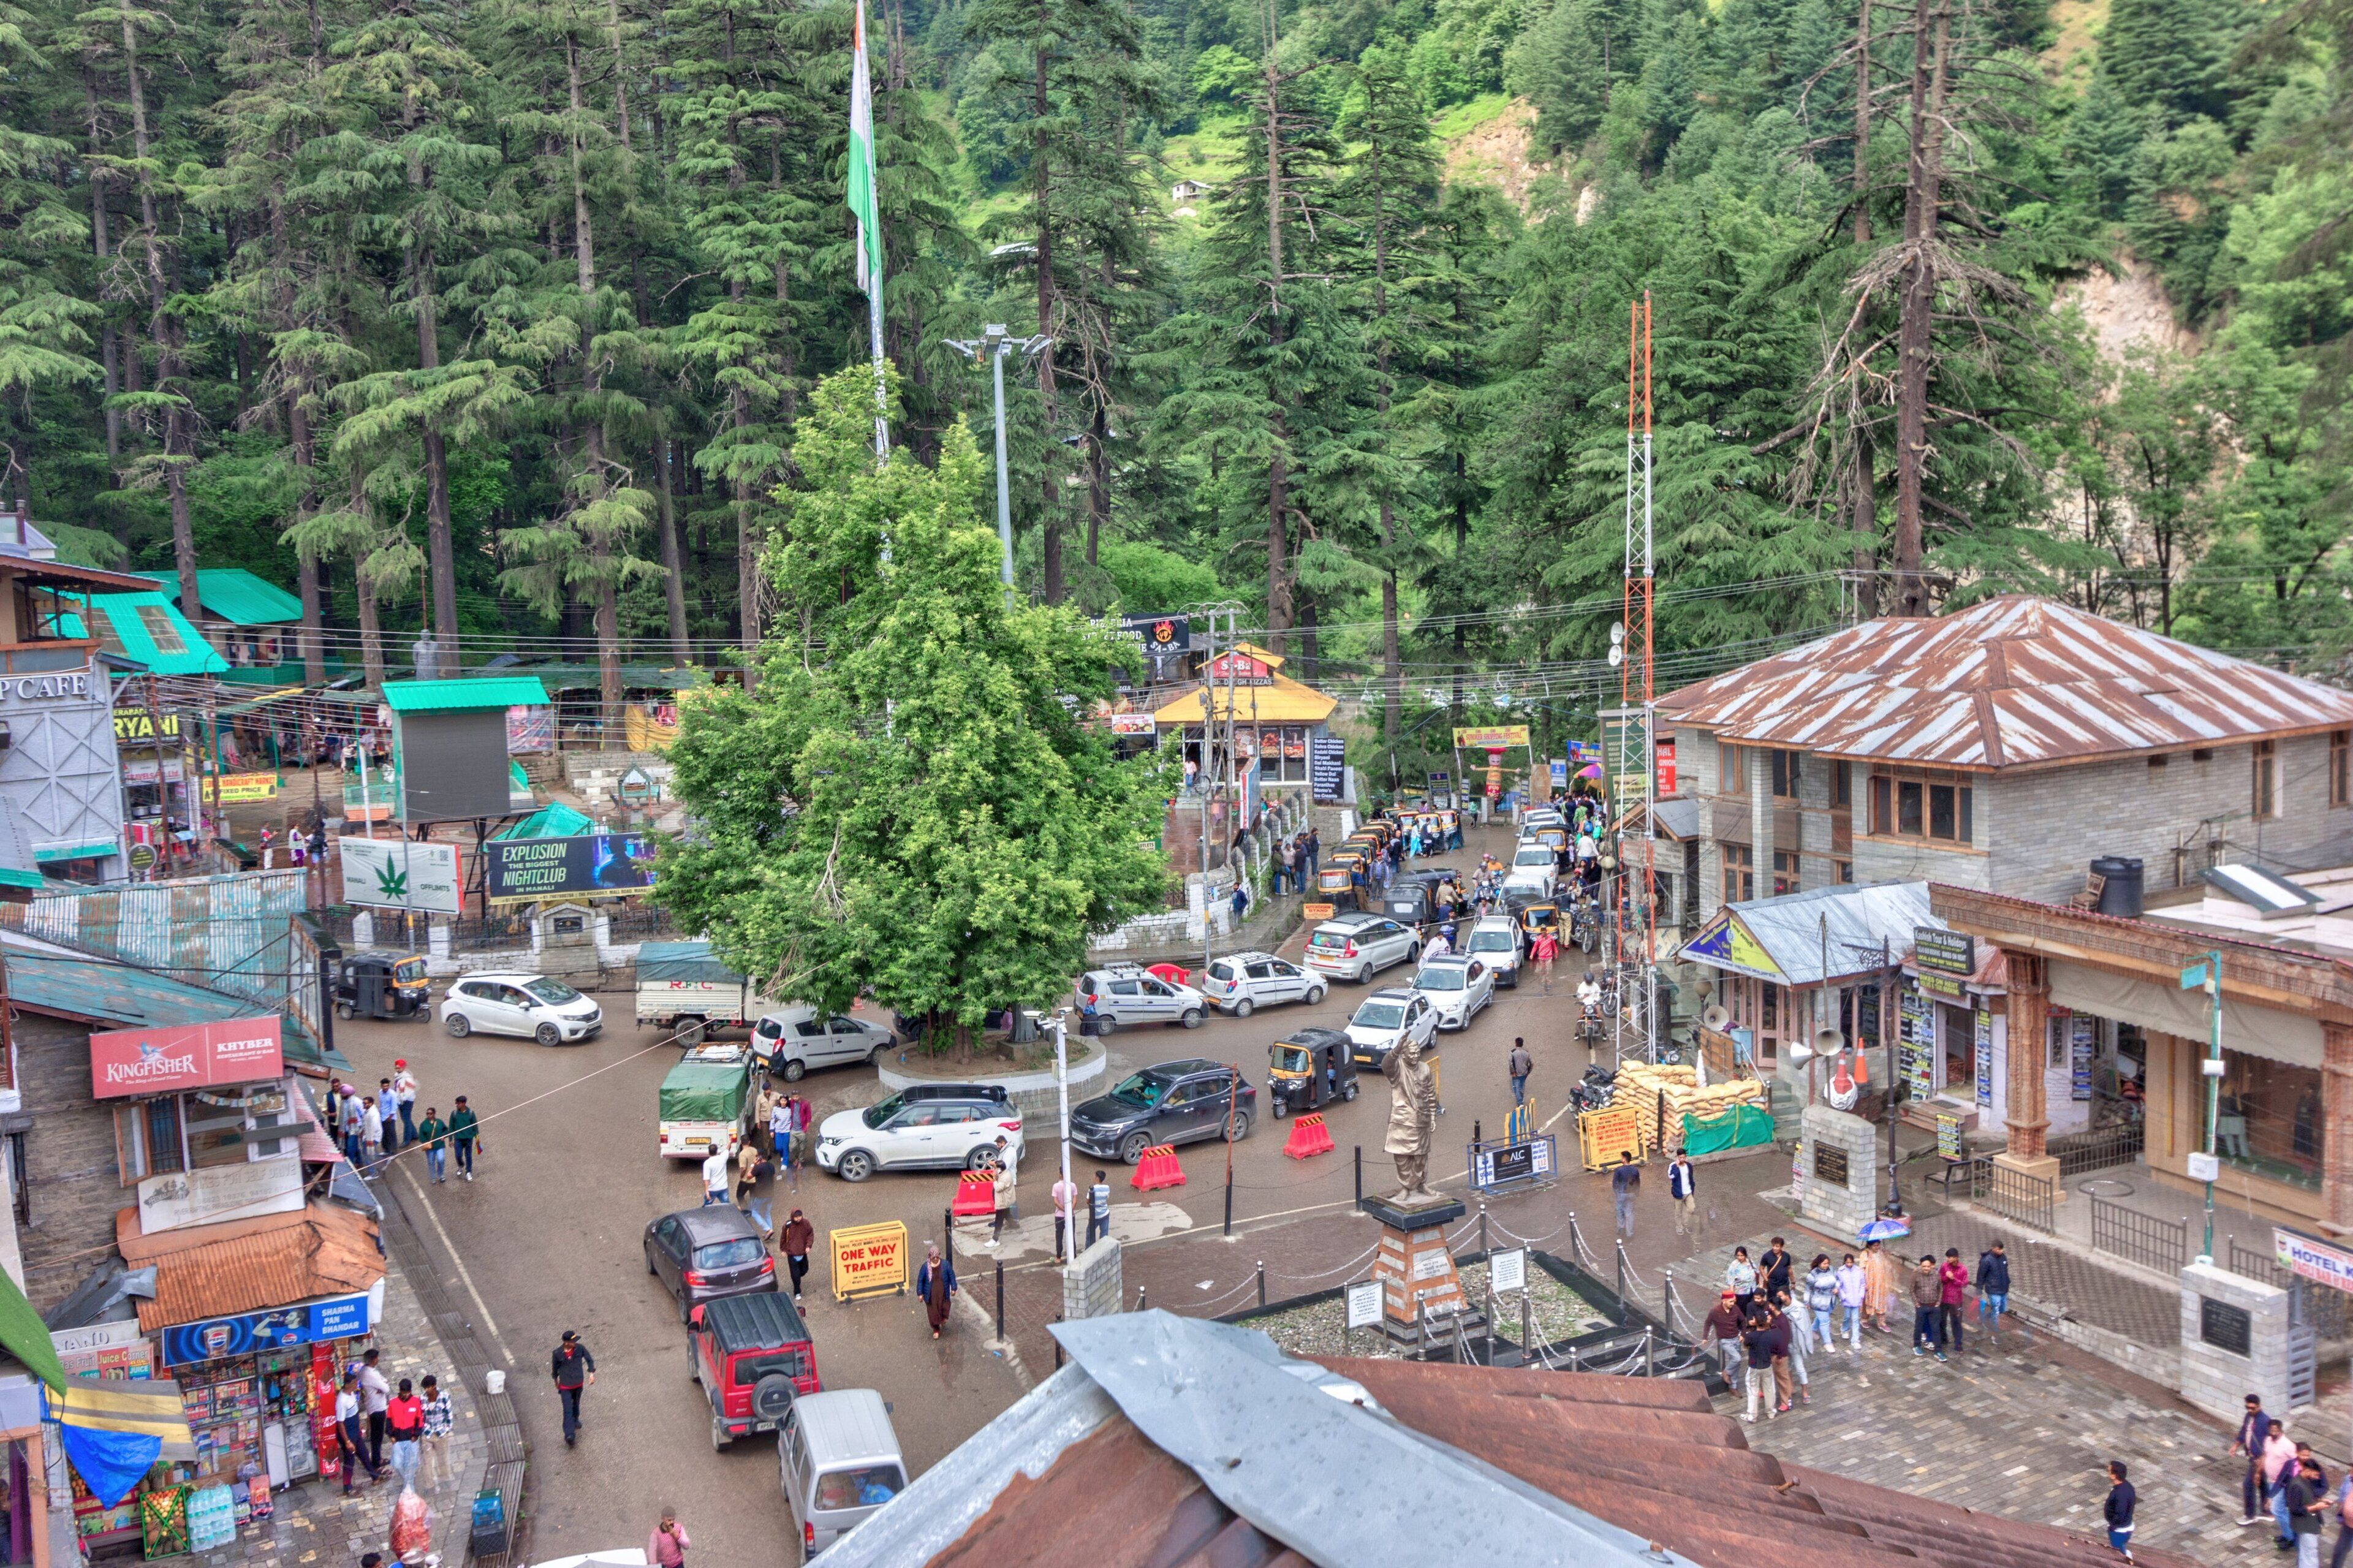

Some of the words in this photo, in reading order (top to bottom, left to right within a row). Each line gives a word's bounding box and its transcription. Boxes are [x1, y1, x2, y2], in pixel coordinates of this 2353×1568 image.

[17, 675, 87, 699] CAFE
[502, 843, 567, 862] EXPLOSION
[525, 860, 559, 869] BIGGEST
[502, 867, 567, 887] NIGHTCLUB
[216, 1037, 275, 1053] KHYBER
[106, 1054, 199, 1083] KINGFISHER
[1510, 1149, 1525, 1162] ALC
[841, 1248, 865, 1261] ONE
[868, 1243, 896, 1257] WAY
[2292, 1246, 2341, 1274] HOTEL
[844, 1257, 893, 1273] TRAFFIC
[321, 1304, 355, 1317] SHARMA
[322, 1321, 360, 1335] BHANDAR
[324, 1316, 340, 1325] PAN
[77, 1354, 97, 1368] Fruit
[98, 1354, 119, 1365] Juice
[121, 1349, 149, 1361] Corner
[129, 1365, 149, 1374] JUICE
